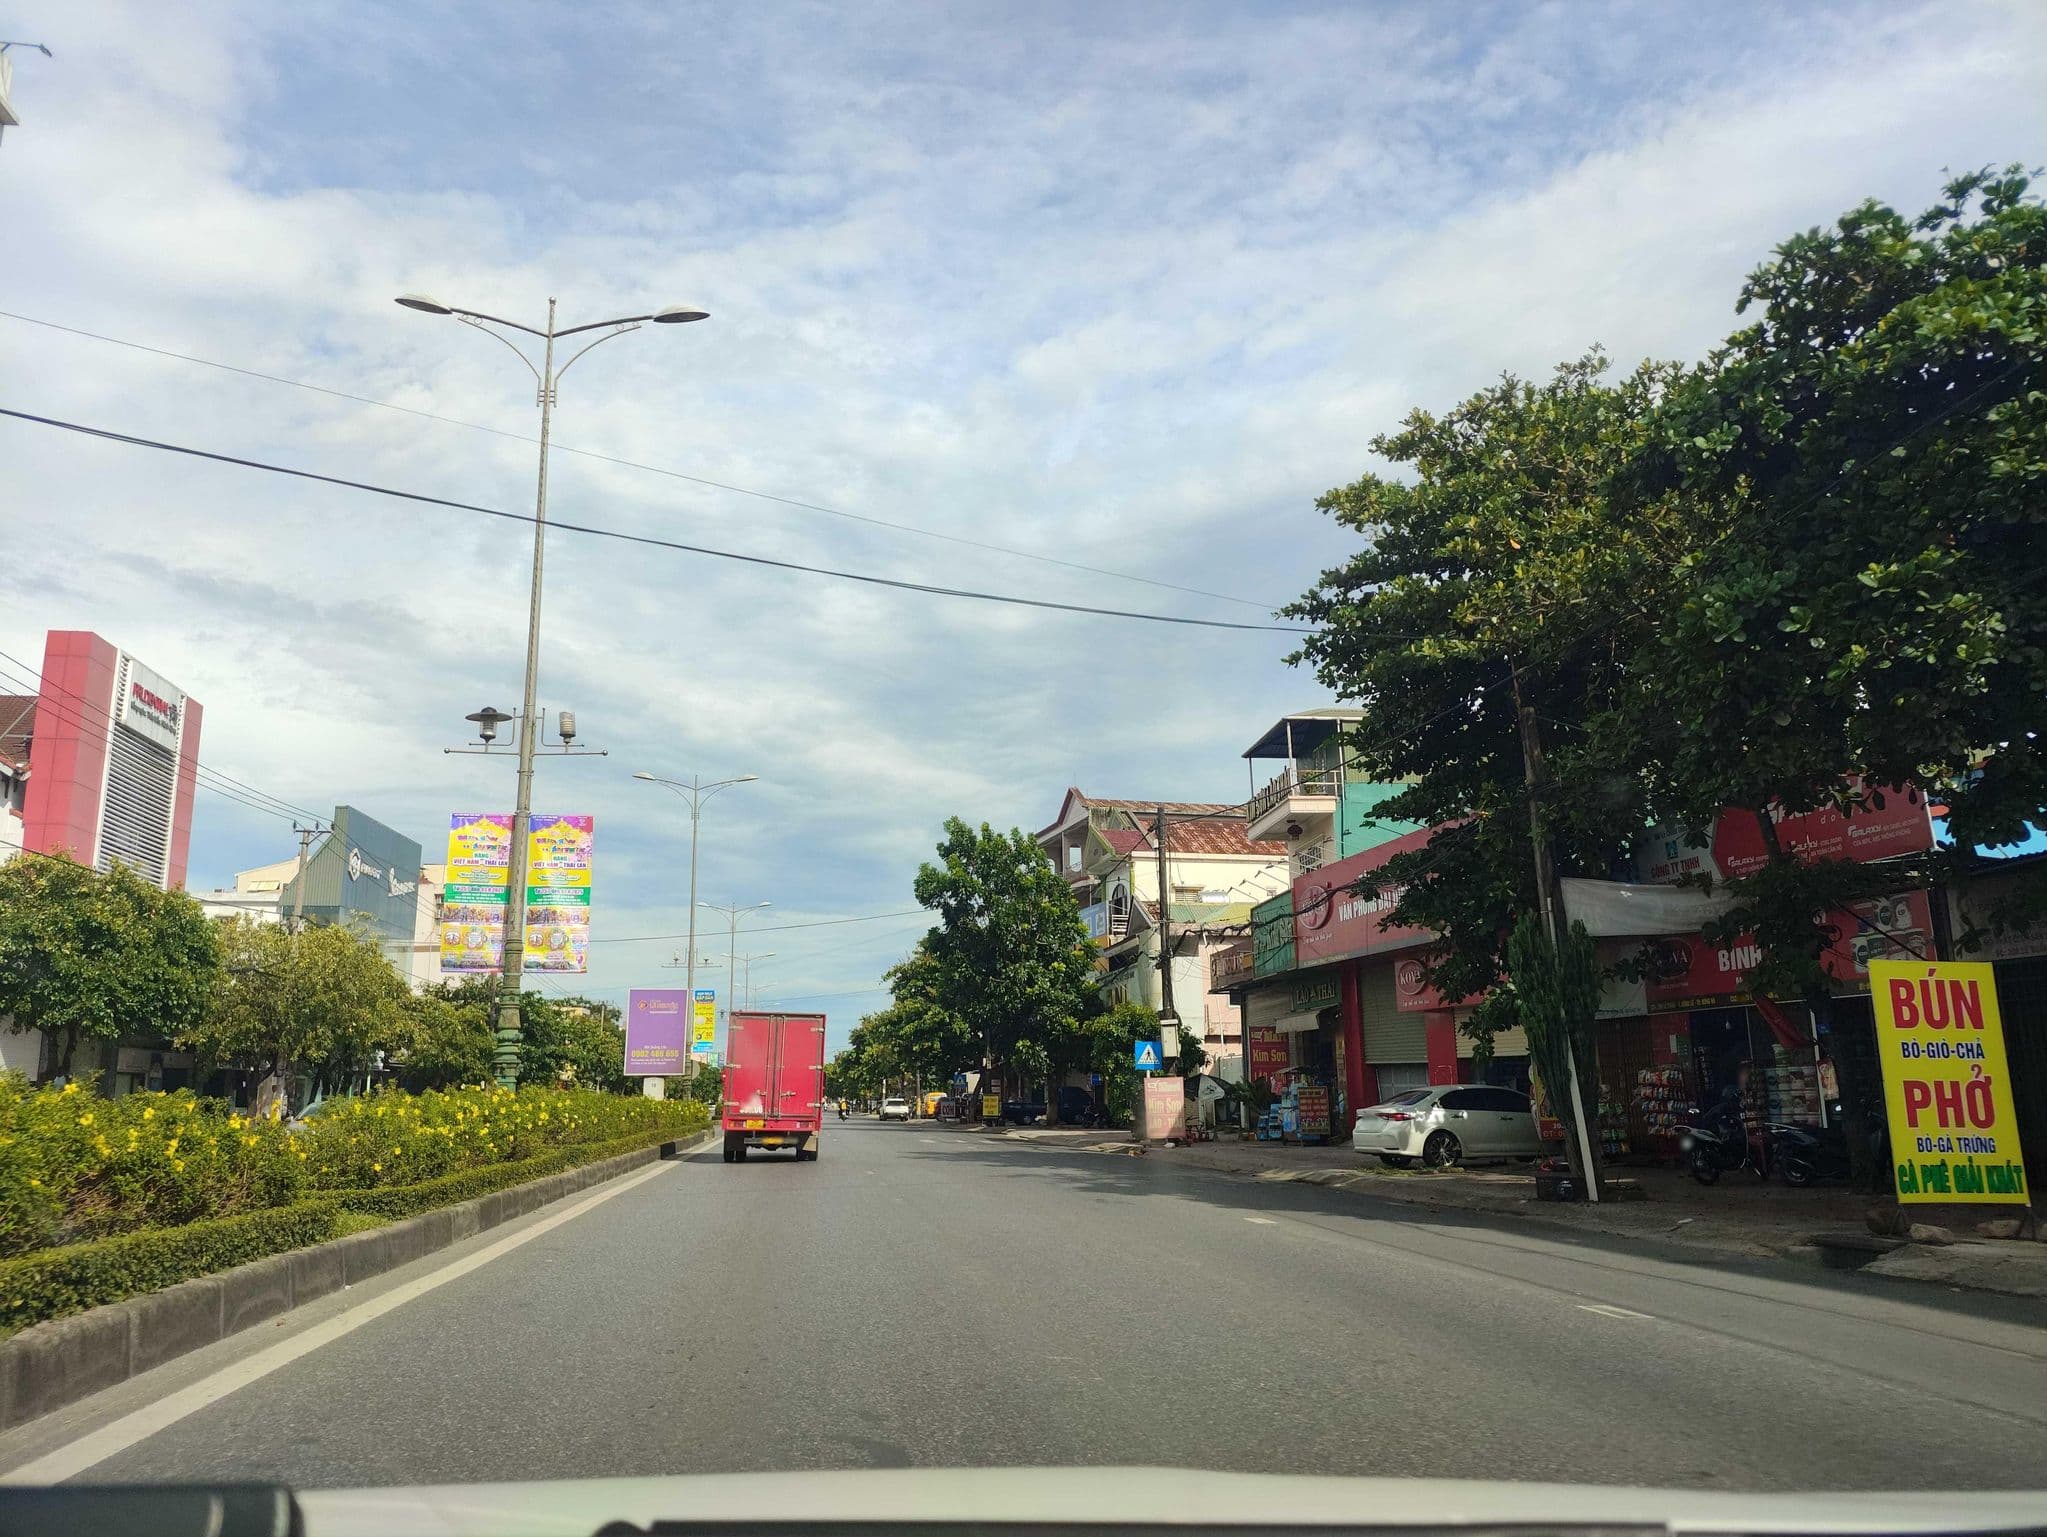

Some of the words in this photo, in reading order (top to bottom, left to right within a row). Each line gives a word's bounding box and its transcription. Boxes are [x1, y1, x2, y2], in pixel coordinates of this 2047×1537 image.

[1888, 967, 1985, 1030] BÚN
[1902, 1063, 1996, 1130] PHỞ
[1920, 1158, 1952, 1194] PHÊ
